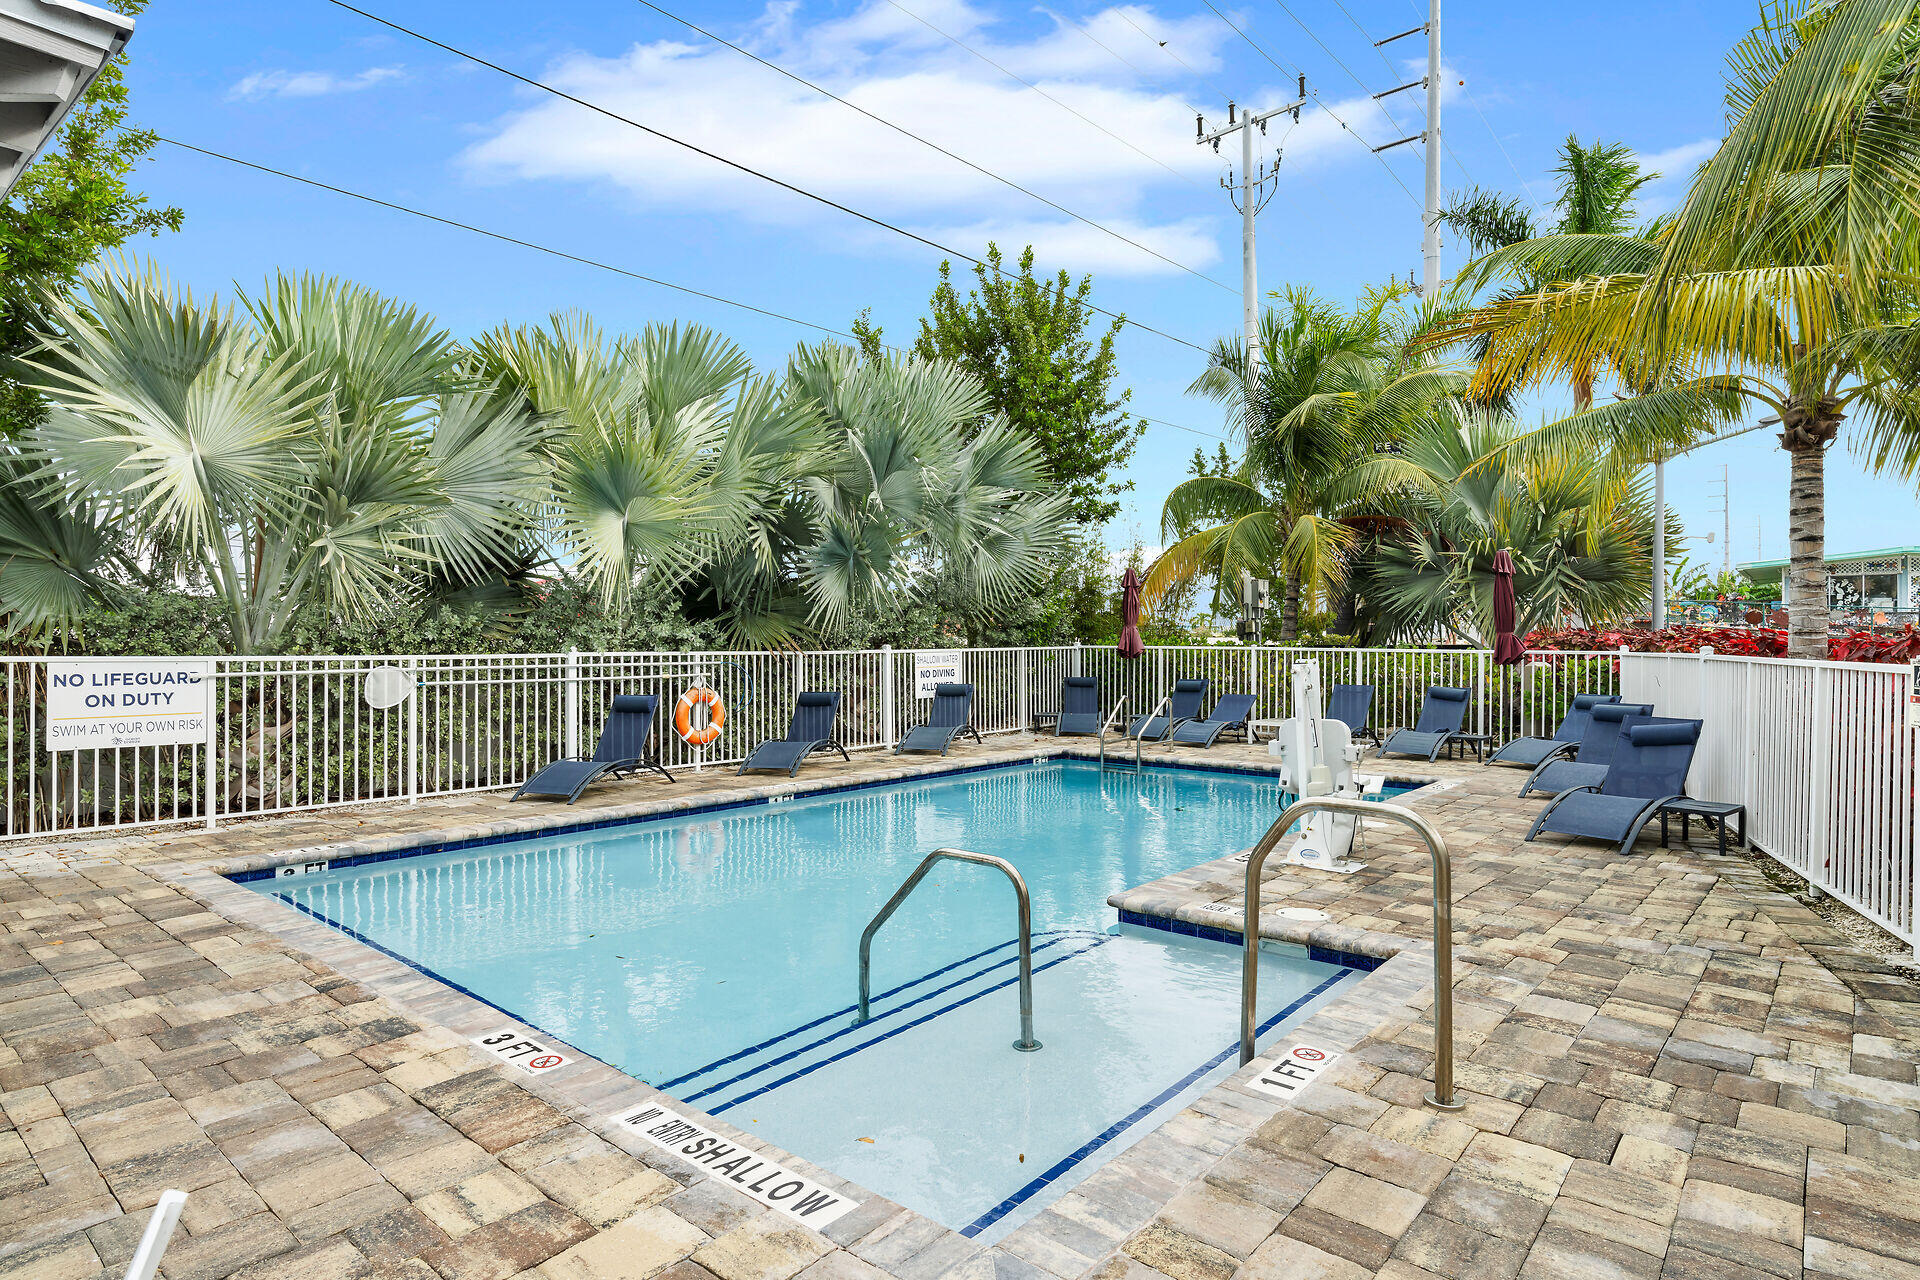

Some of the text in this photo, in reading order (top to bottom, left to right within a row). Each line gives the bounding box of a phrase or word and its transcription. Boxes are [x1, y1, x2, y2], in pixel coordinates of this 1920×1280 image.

[53, 671, 202, 688] NO LIFEGUARD
[920, 668, 956, 679] NO DIVING
[85, 692, 174, 708] ON DUTY
[52, 719, 203, 738] SWIM AT YOUR OWN RISK
[482, 1033, 544, 1059] 3 FT
[1271, 1059, 1315, 1081] FT
[1260, 1077, 1296, 1091] 1
[624, 1107, 839, 1217] NO ENTRY SHALLOW
